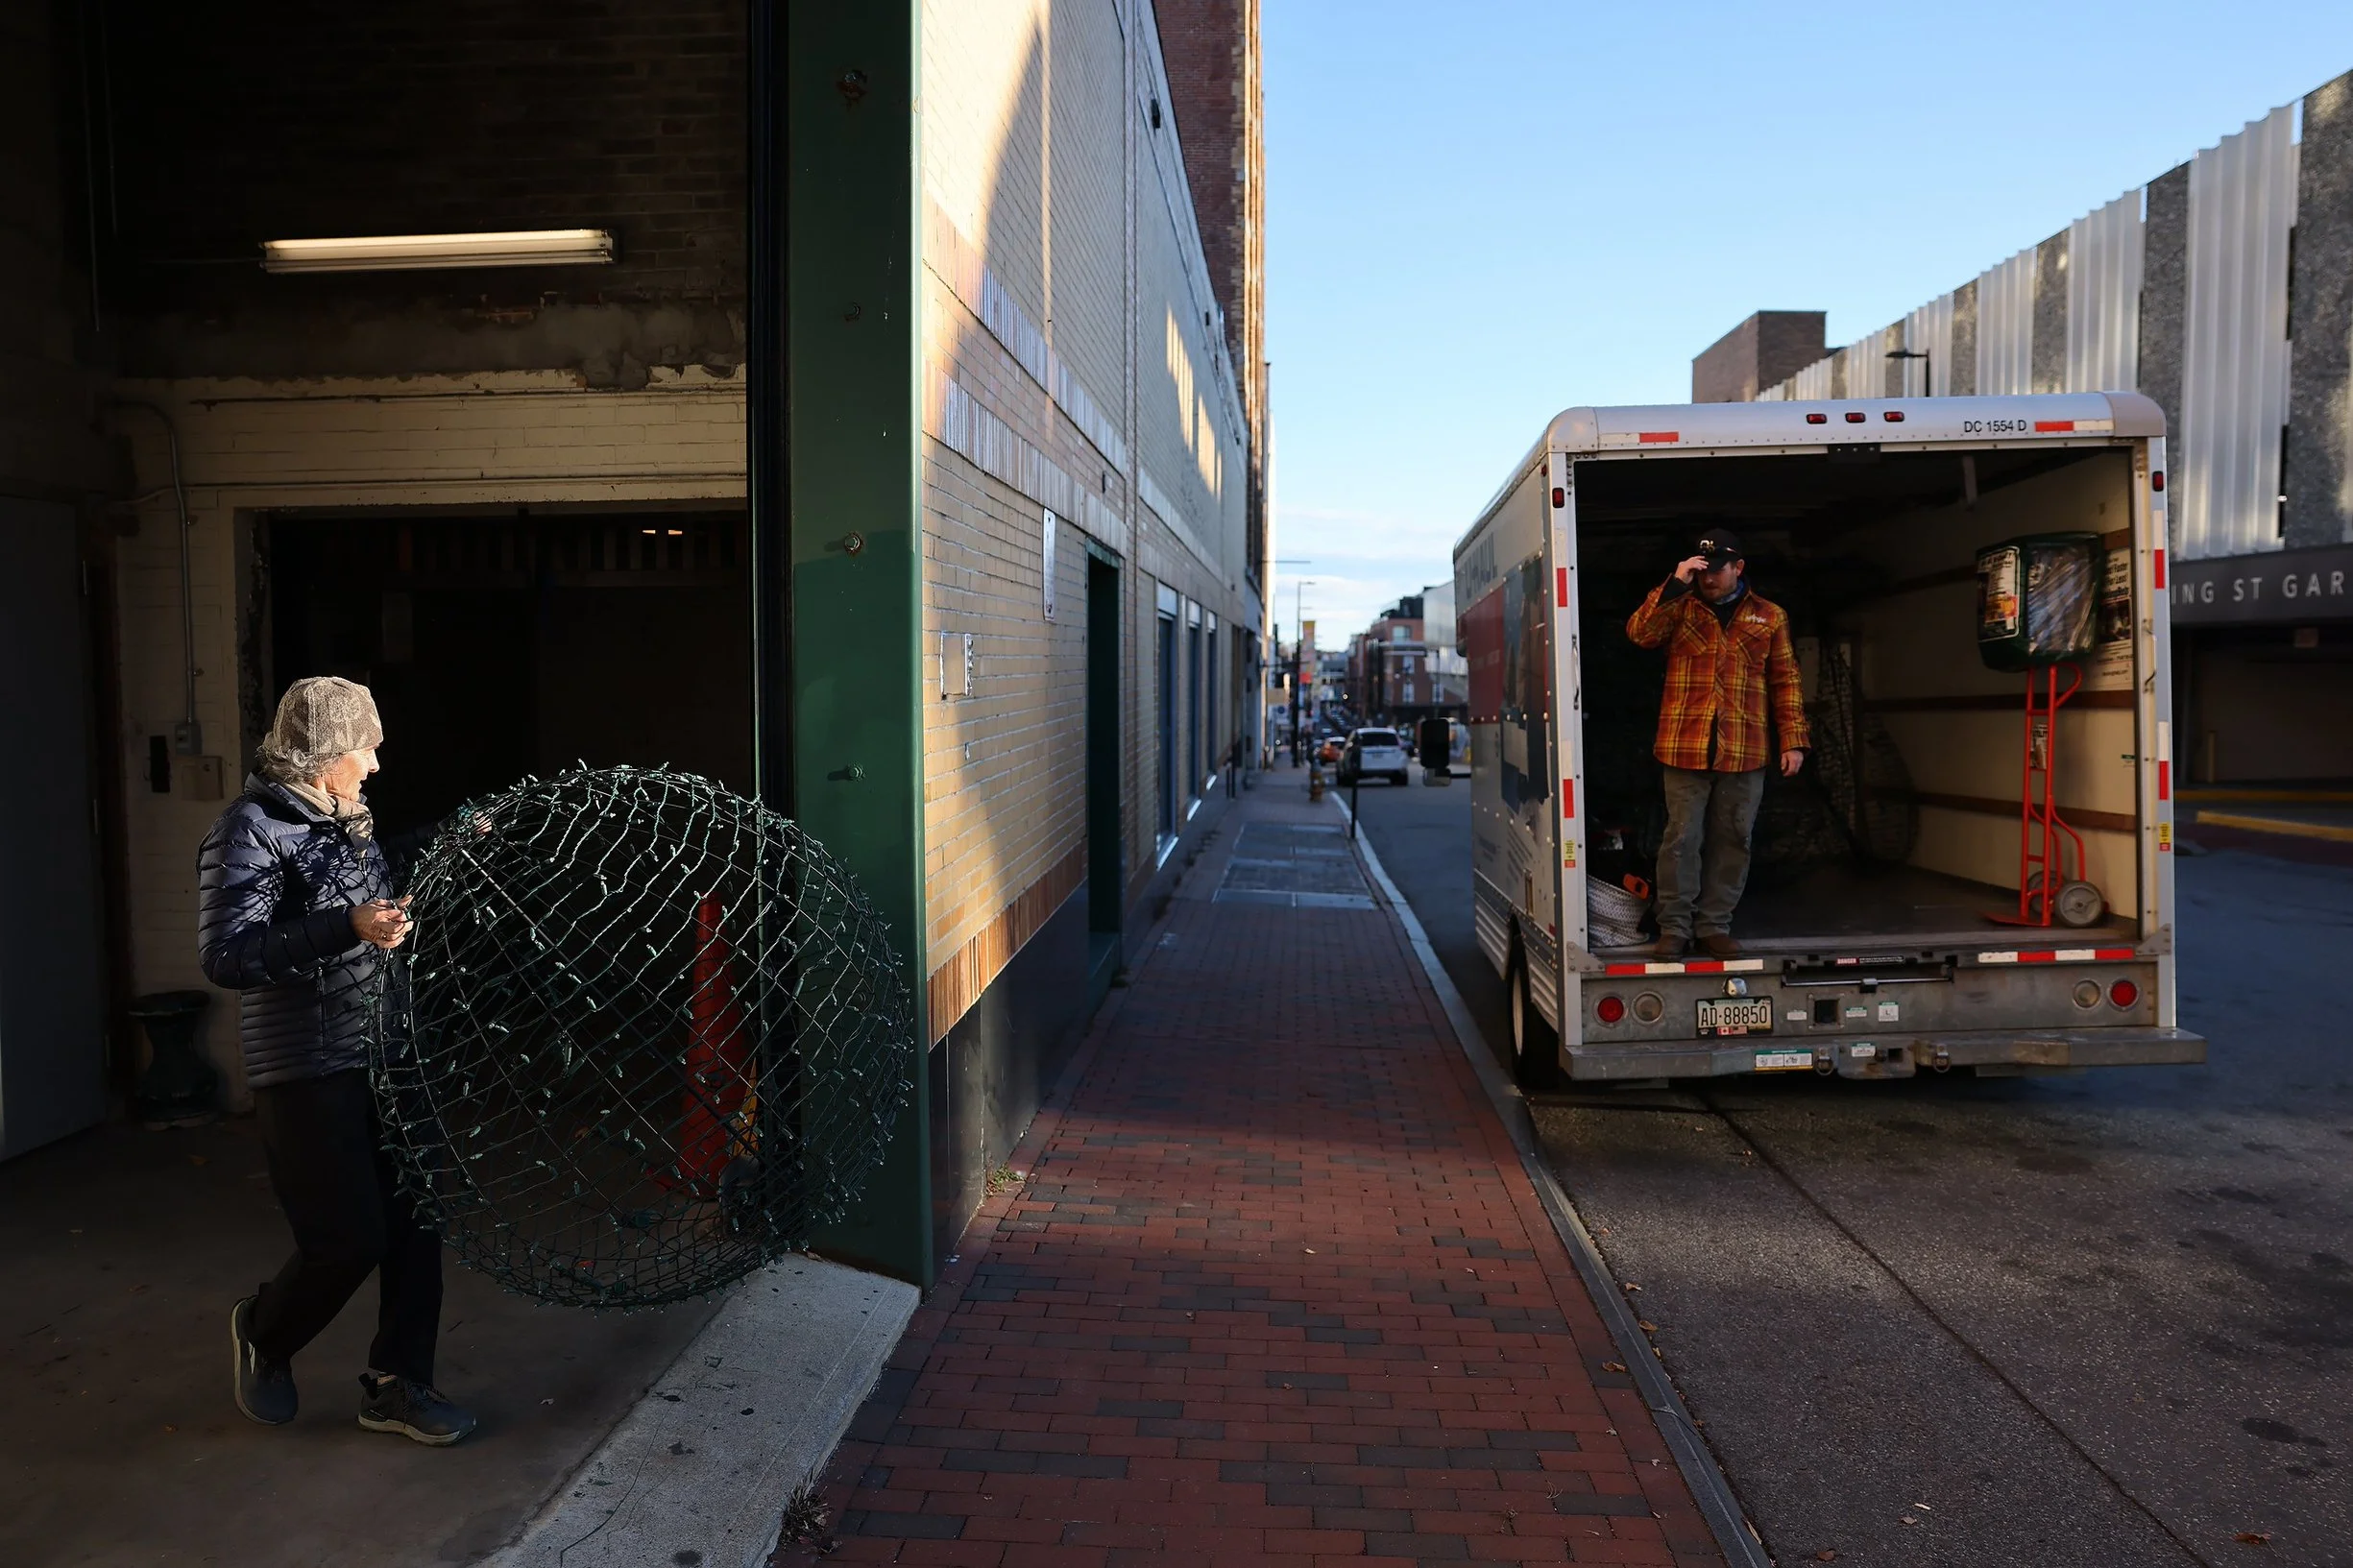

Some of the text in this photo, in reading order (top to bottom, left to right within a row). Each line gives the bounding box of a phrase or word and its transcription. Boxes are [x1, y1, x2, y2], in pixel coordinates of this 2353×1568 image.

[1963, 419, 2027, 433] DC 1554 D
[2171, 570, 2345, 604] ING ST GAR
